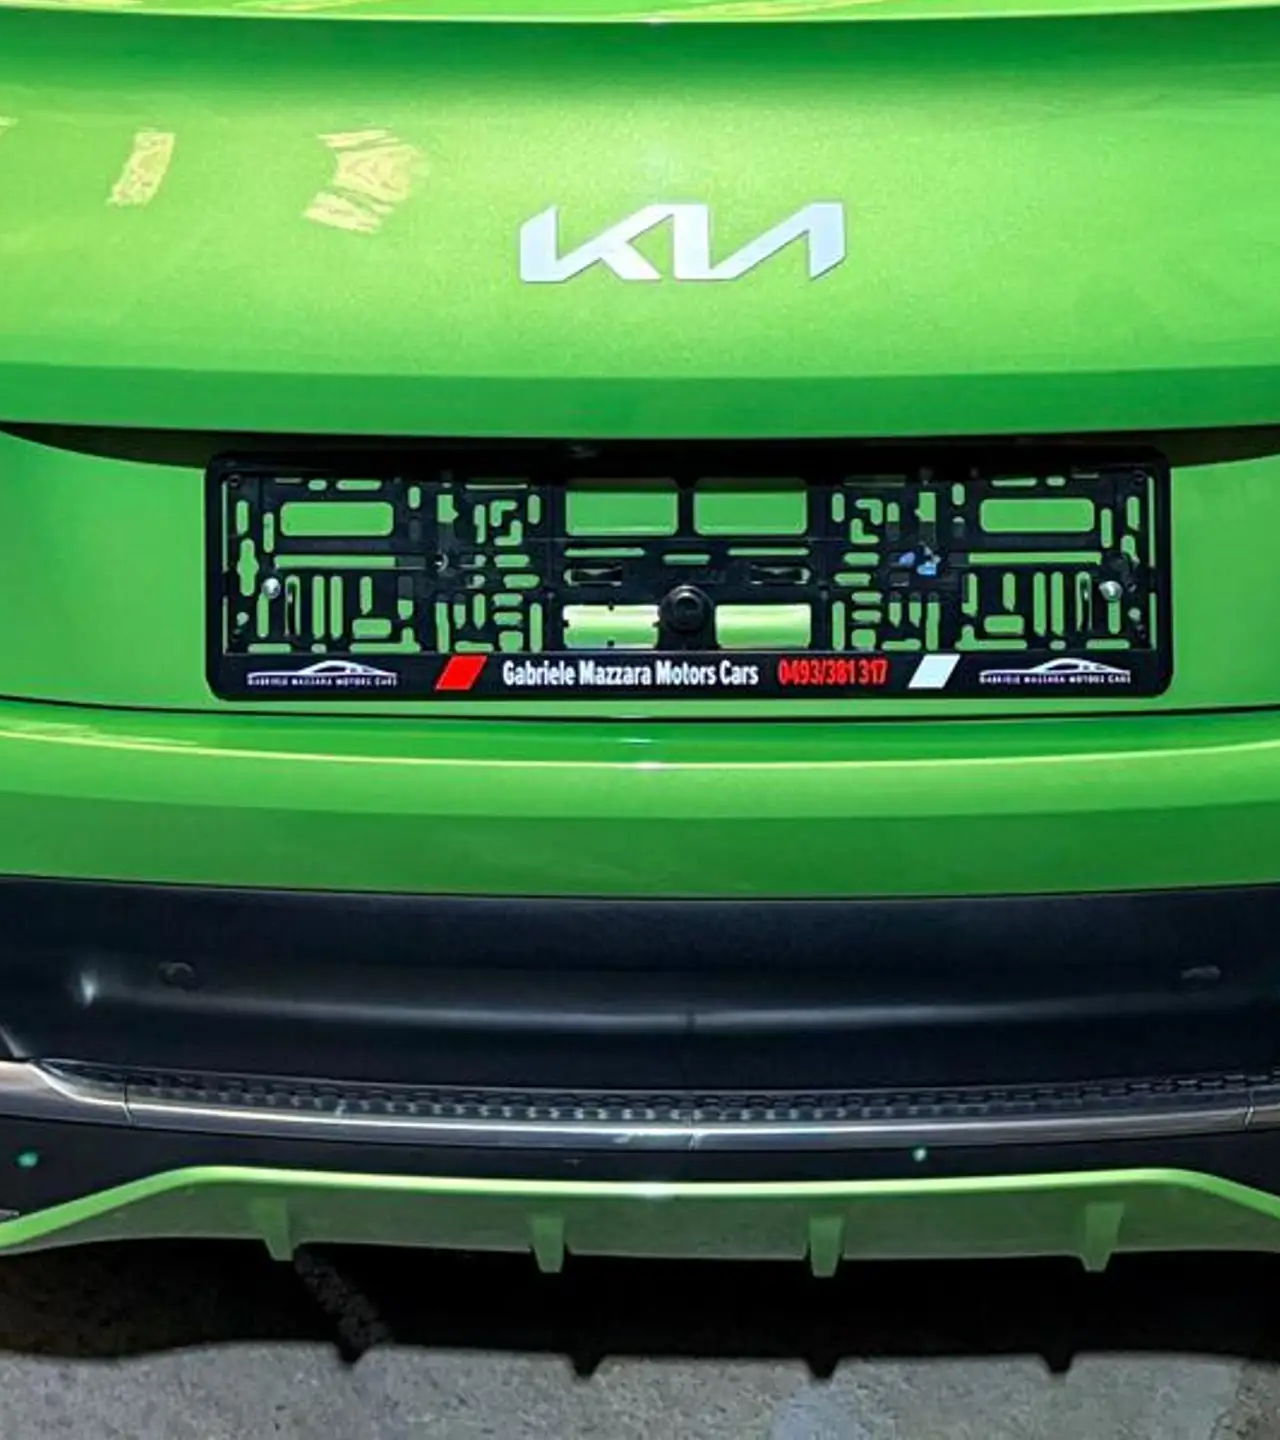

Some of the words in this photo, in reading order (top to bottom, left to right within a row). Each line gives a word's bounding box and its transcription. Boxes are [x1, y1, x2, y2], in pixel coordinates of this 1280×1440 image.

[519, 203, 845, 284] KIA
[502, 659, 576, 686] Gabriele
[578, 659, 652, 686] Mazzara
[655, 659, 717, 686] Motors
[720, 659, 760, 686] Cars
